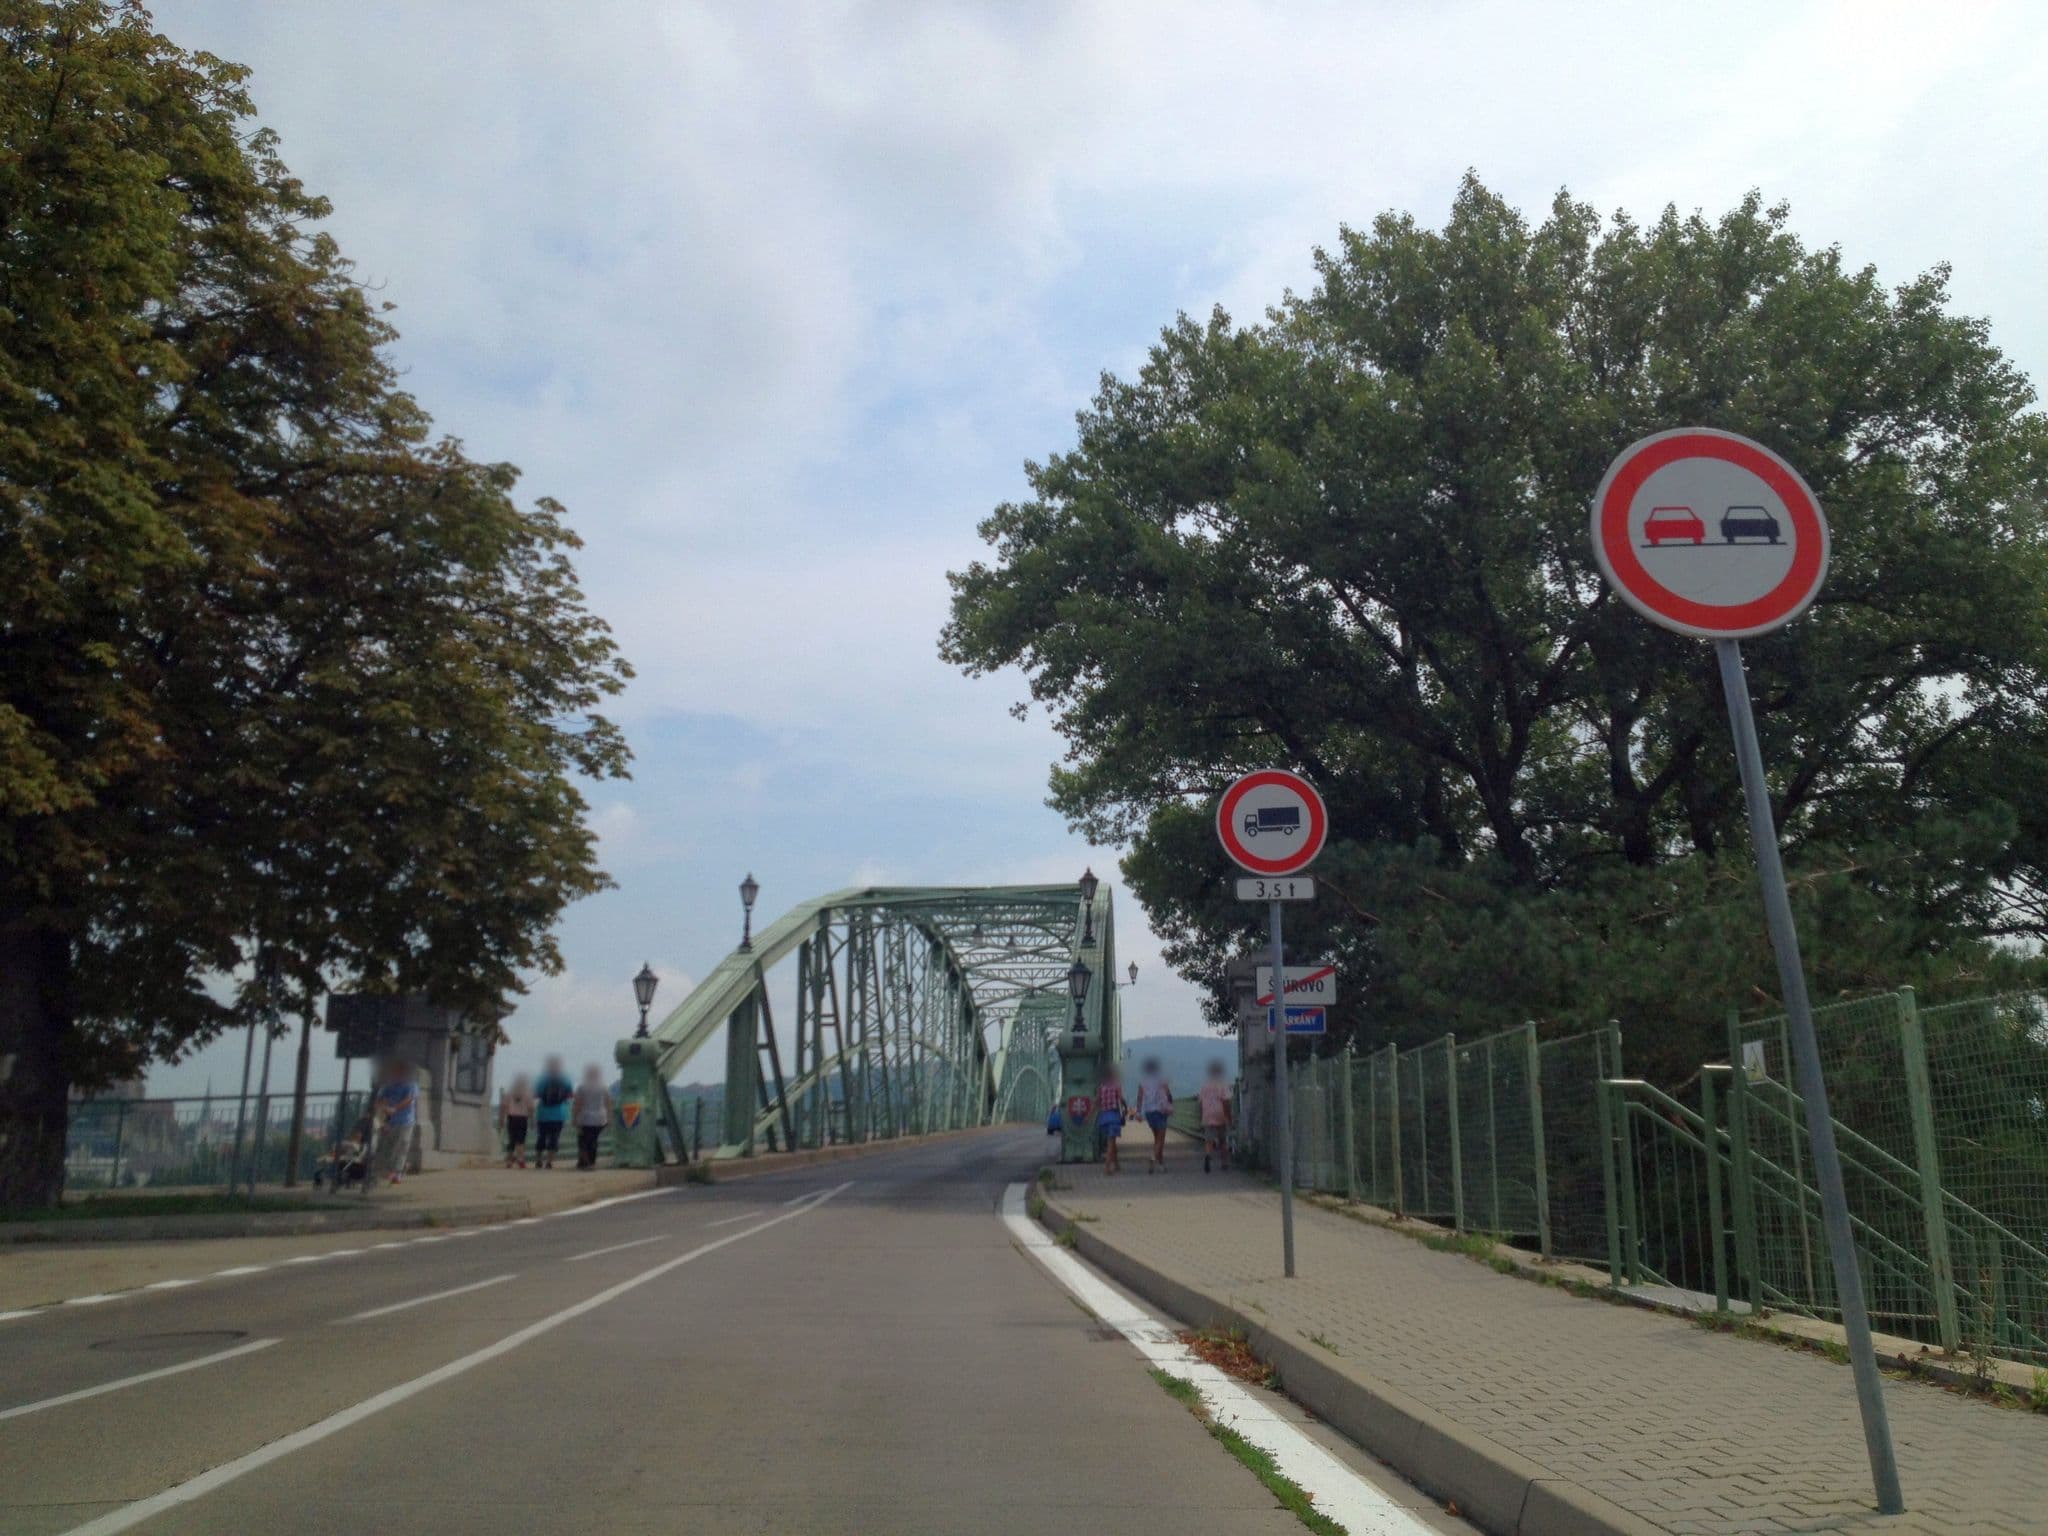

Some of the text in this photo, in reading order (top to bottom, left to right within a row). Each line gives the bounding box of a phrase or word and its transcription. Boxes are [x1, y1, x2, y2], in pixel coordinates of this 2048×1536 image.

[1256, 881, 1295, 900] 3,5 t
[1268, 976, 1324, 993] ŠÚROVO
[1284, 1013, 1316, 1025] RKÁNY
